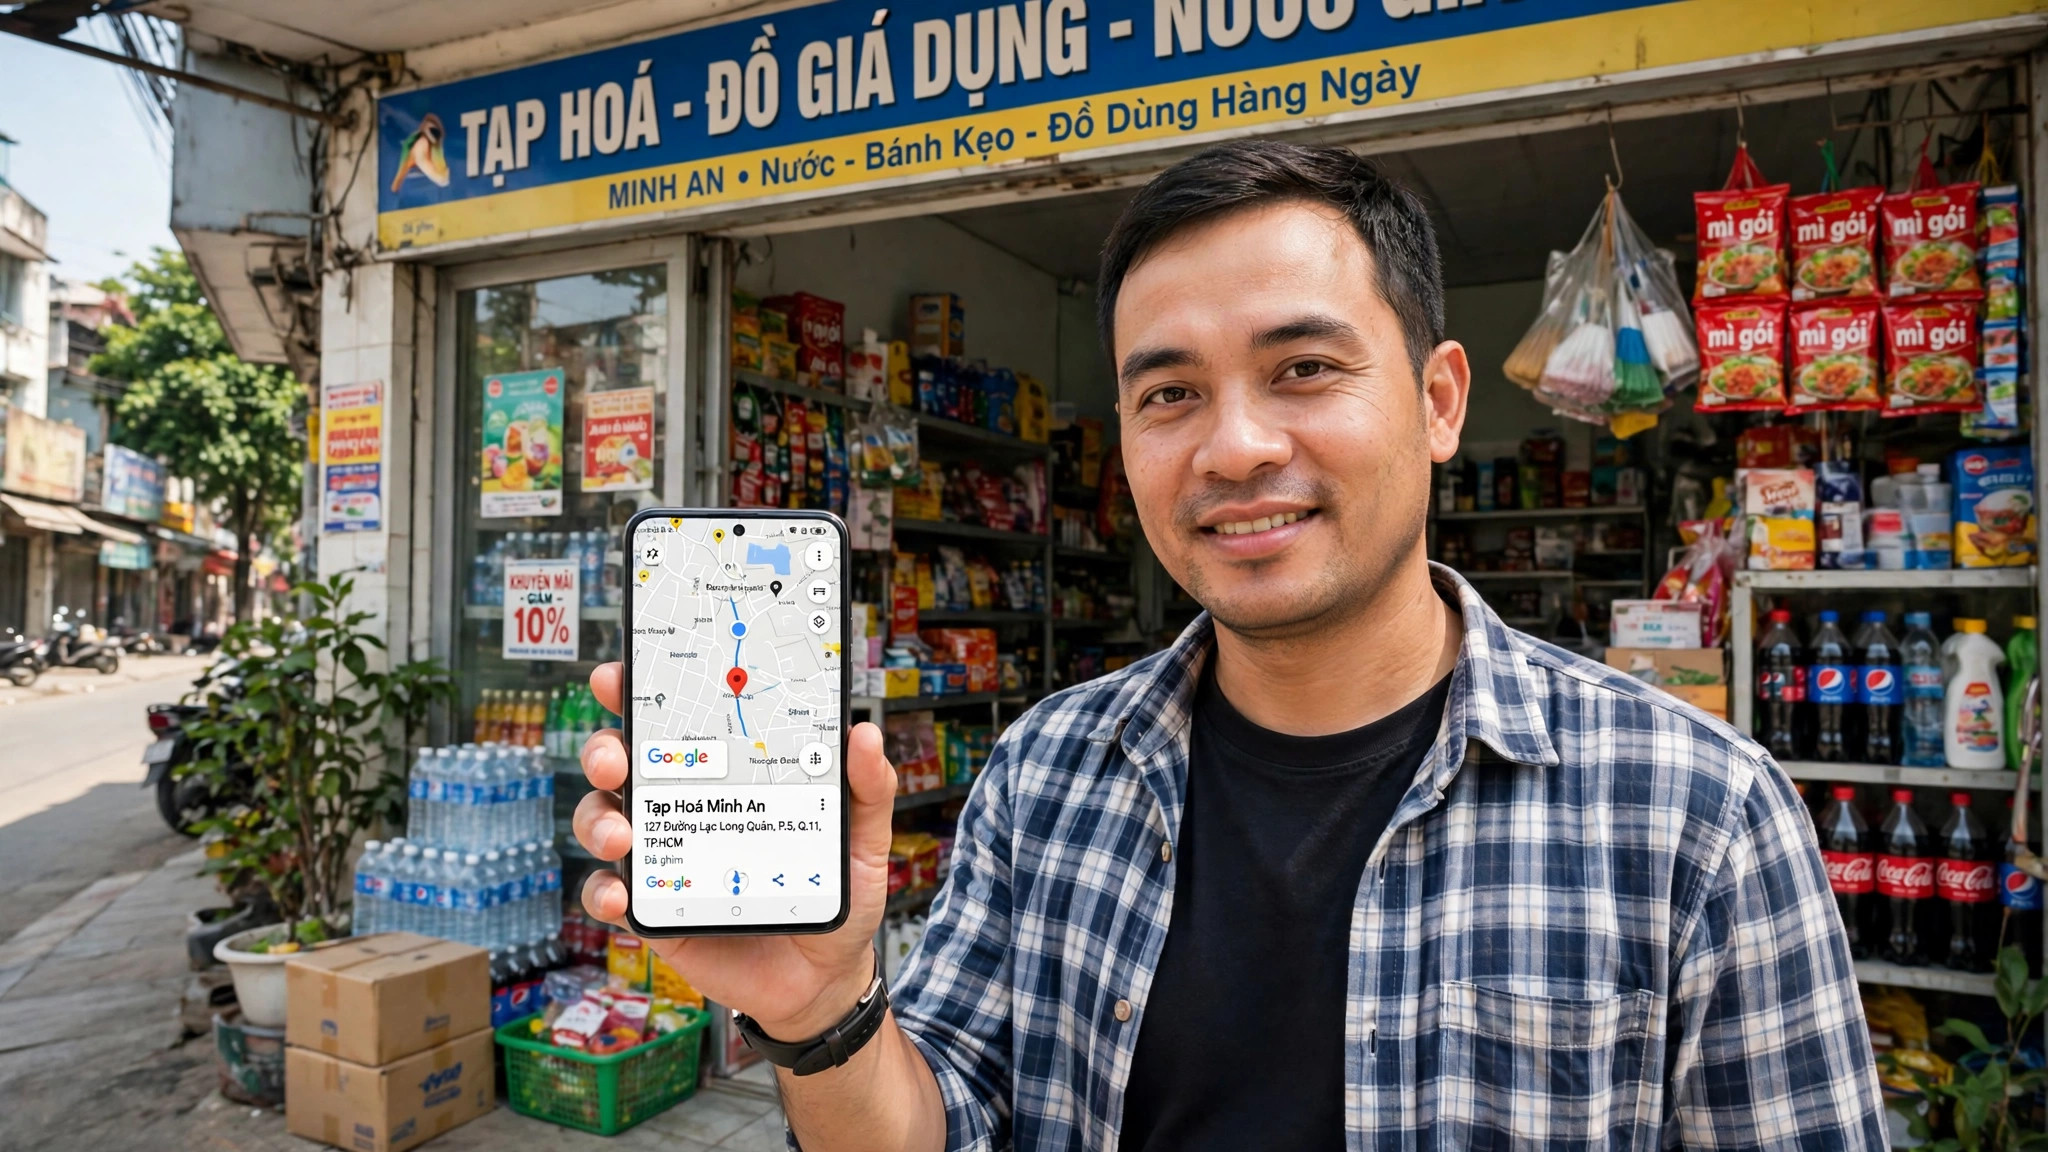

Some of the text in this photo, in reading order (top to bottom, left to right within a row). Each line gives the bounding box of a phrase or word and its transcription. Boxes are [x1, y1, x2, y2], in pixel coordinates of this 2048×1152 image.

[460, 99, 546, 188] TẠP
[560, 59, 660, 161] HOÁ
[705, 22, 778, 136] ĐỒ
[799, 8, 895, 120] GIÁ
[912, 0, 1088, 108] DỤNG
[608, 172, 677, 210] MINH
[686, 166, 724, 198] AN
[761, 150, 835, 187] Nước
[866, 130, 943, 172] Bánh
[953, 126, 1015, 160] Kẹo
[1048, 100, 1094, 144] Đồ
[1107, 97, 1198, 133] Dùng
[1211, 80, 1308, 119] Hàng
[1321, 59, 1422, 107] Ngày
[1707, 210, 1774, 241] mì gói
[1798, 212, 1867, 244] mì gói
[1893, 204, 1966, 238] mì gói
[1708, 320, 1774, 350] mì gói
[1799, 319, 1868, 350] mì gói
[1896, 319, 1966, 350] mì gói
[514, 606, 569, 644] 10%
[647, 748, 708, 767] Google
[644, 798, 766, 817] Tạp Hoá Minh An
[644, 821, 661, 832] 127
[663, 820, 697, 834] Đường
[699, 821, 717, 834] Lạc
[778, 820, 796, 832] P.5,
[798, 820, 822, 832] Q.11,
[644, 837, 683, 848] TP.HCM
[646, 875, 692, 891] Google
